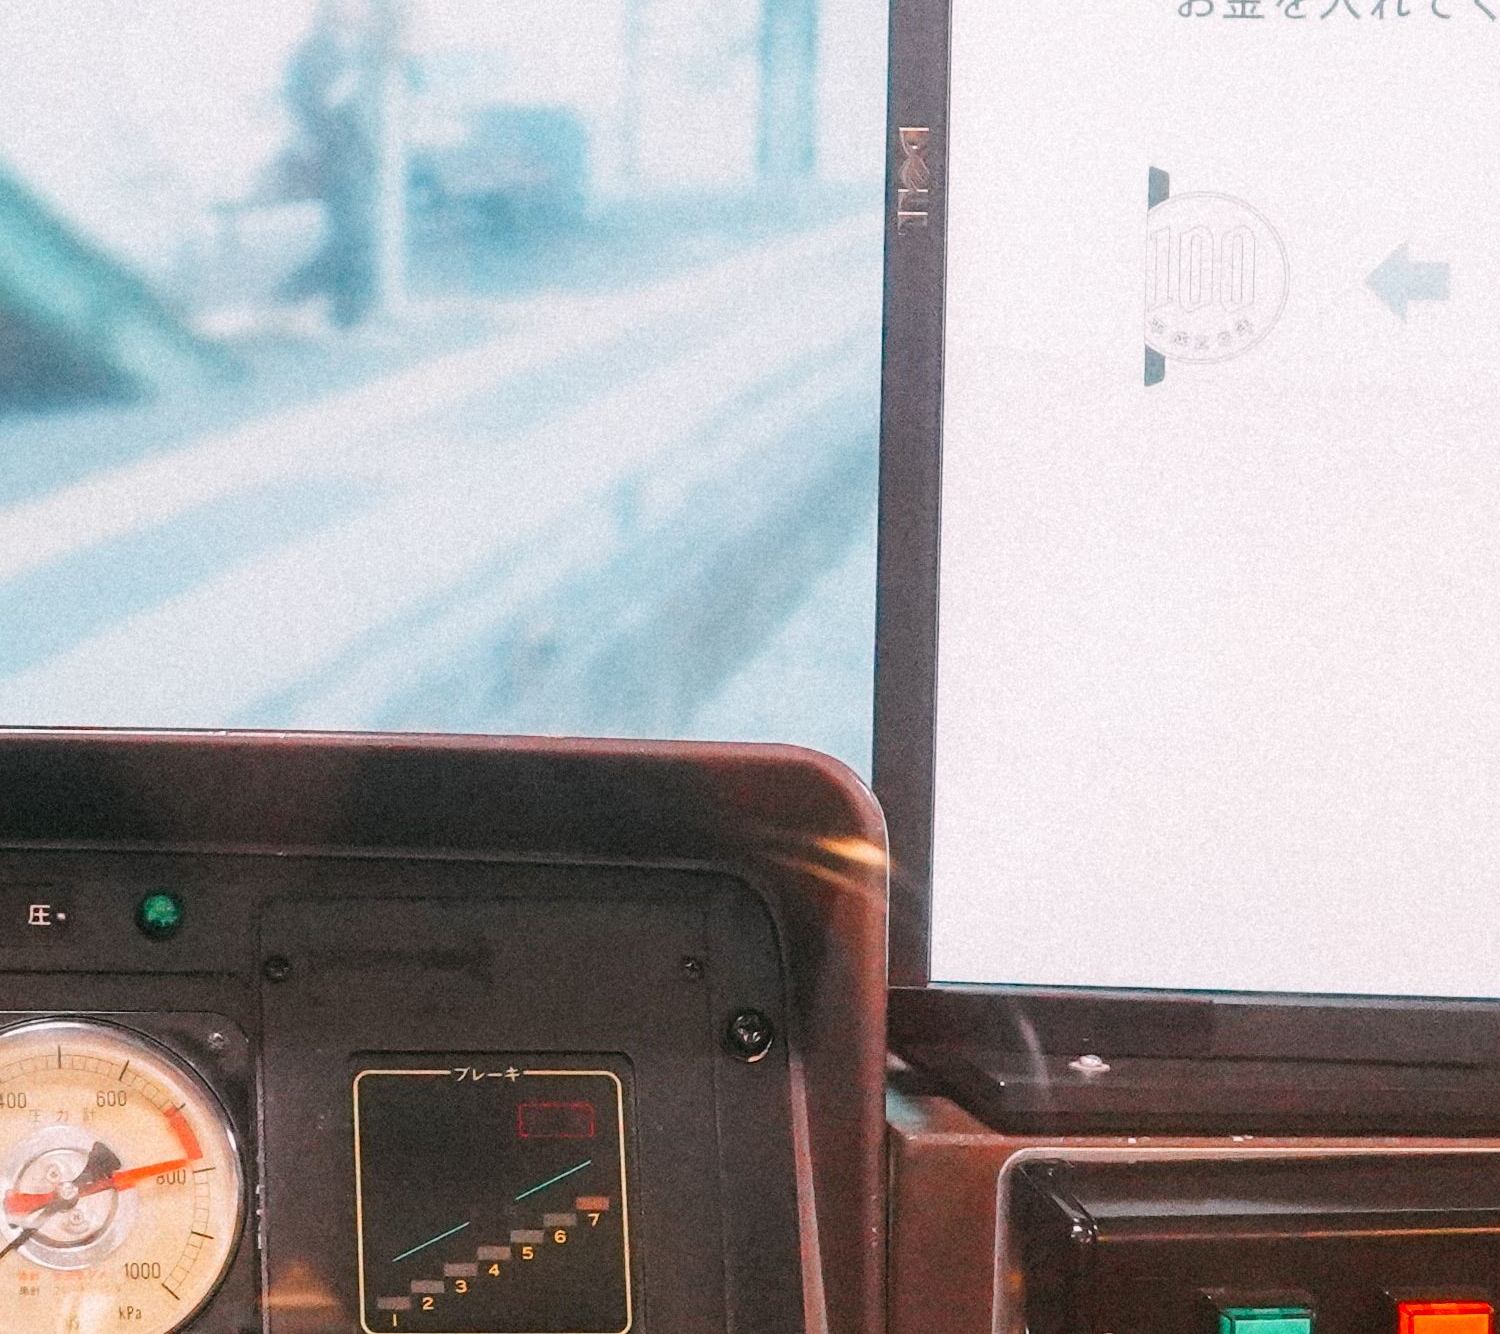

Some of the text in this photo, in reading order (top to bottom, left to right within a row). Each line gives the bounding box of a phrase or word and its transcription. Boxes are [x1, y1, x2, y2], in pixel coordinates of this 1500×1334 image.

[453, 1066, 521, 1082] ブレーキ
[95, 1090, 128, 1107] 600
[587, 1212, 601, 1227] 7
[553, 1229, 567, 1244] 6
[521, 1246, 534, 1260] 5
[124, 1262, 162, 1280] 1000
[488, 1263, 500, 1277] 4
[455, 1279, 468, 1294] 3
[422, 1296, 435, 1311] 2
[118, 1305, 143, 1321] kPa
